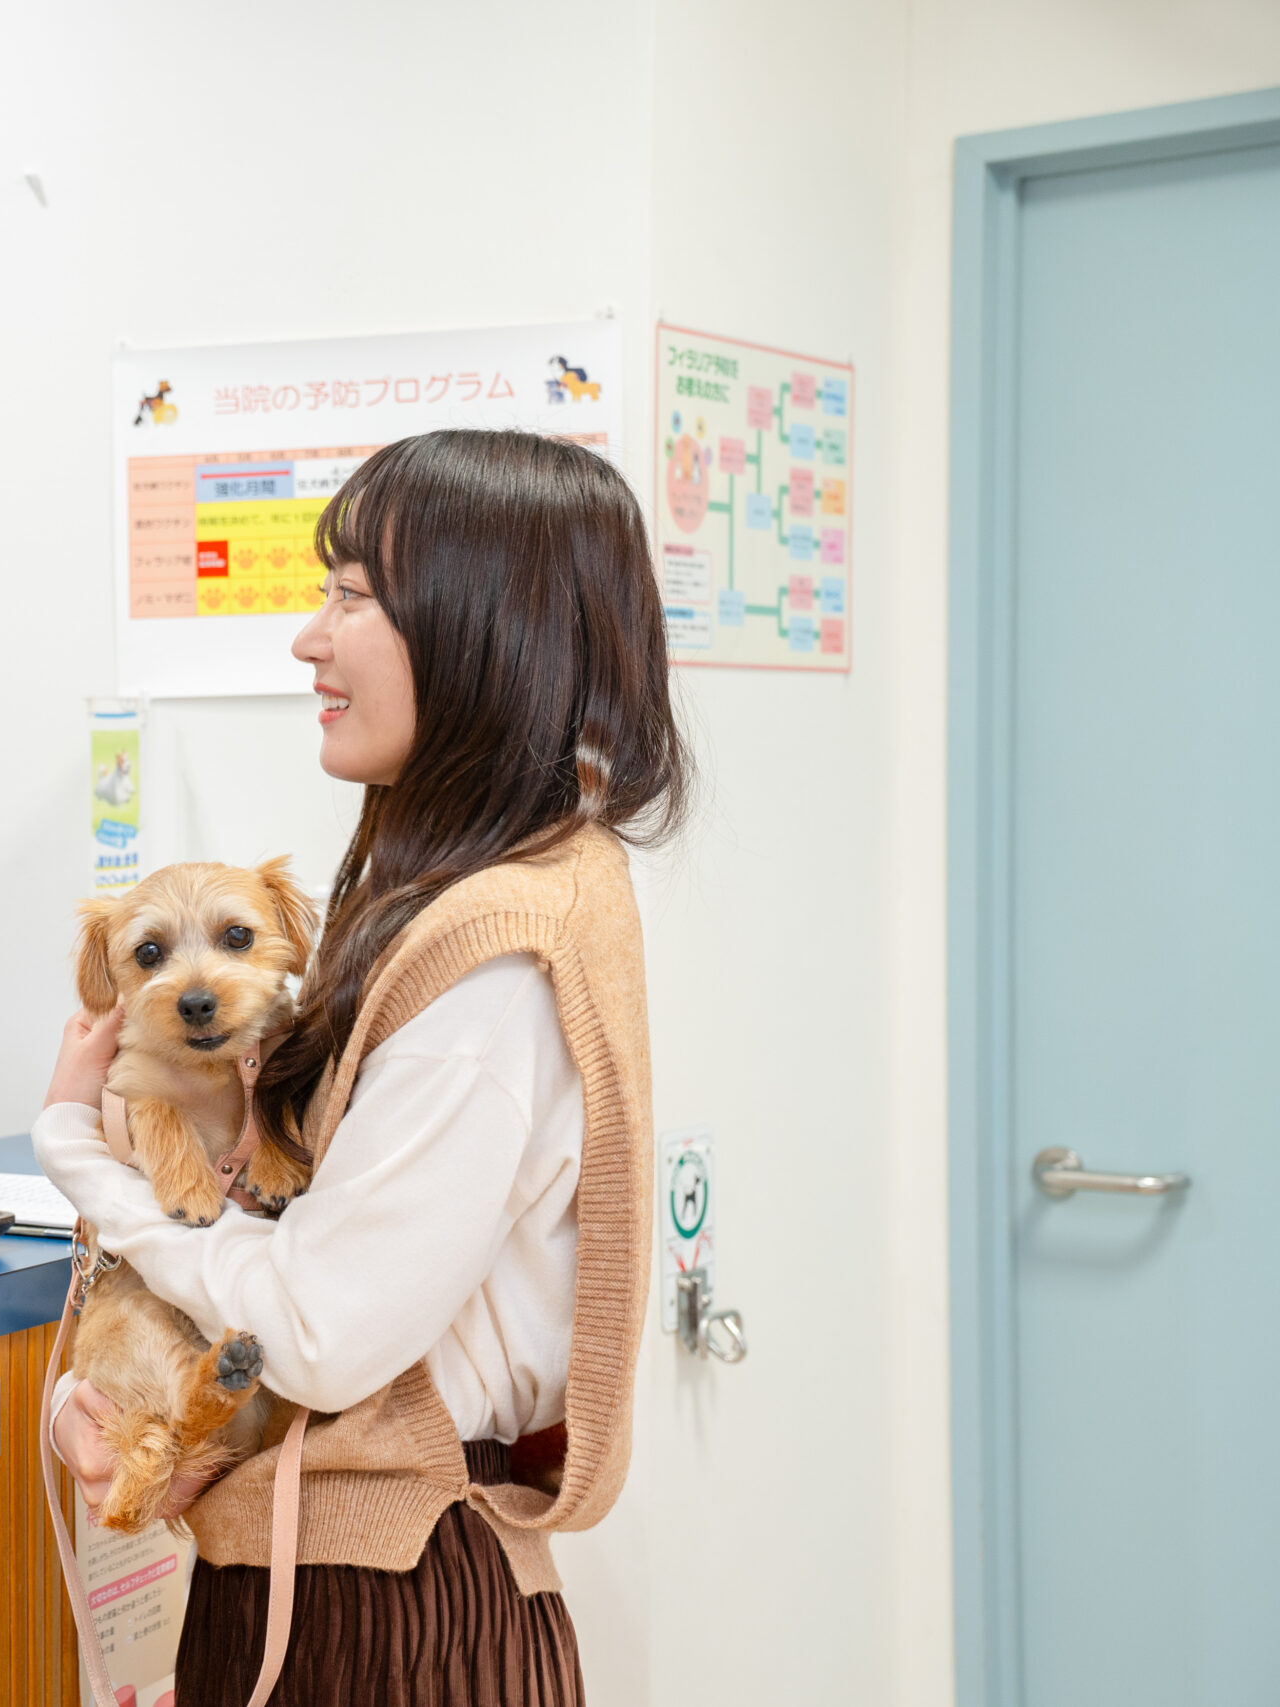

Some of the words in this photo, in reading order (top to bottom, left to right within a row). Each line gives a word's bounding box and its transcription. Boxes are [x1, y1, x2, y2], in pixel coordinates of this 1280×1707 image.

[213, 371, 517, 416] 当院の予防プログラム
